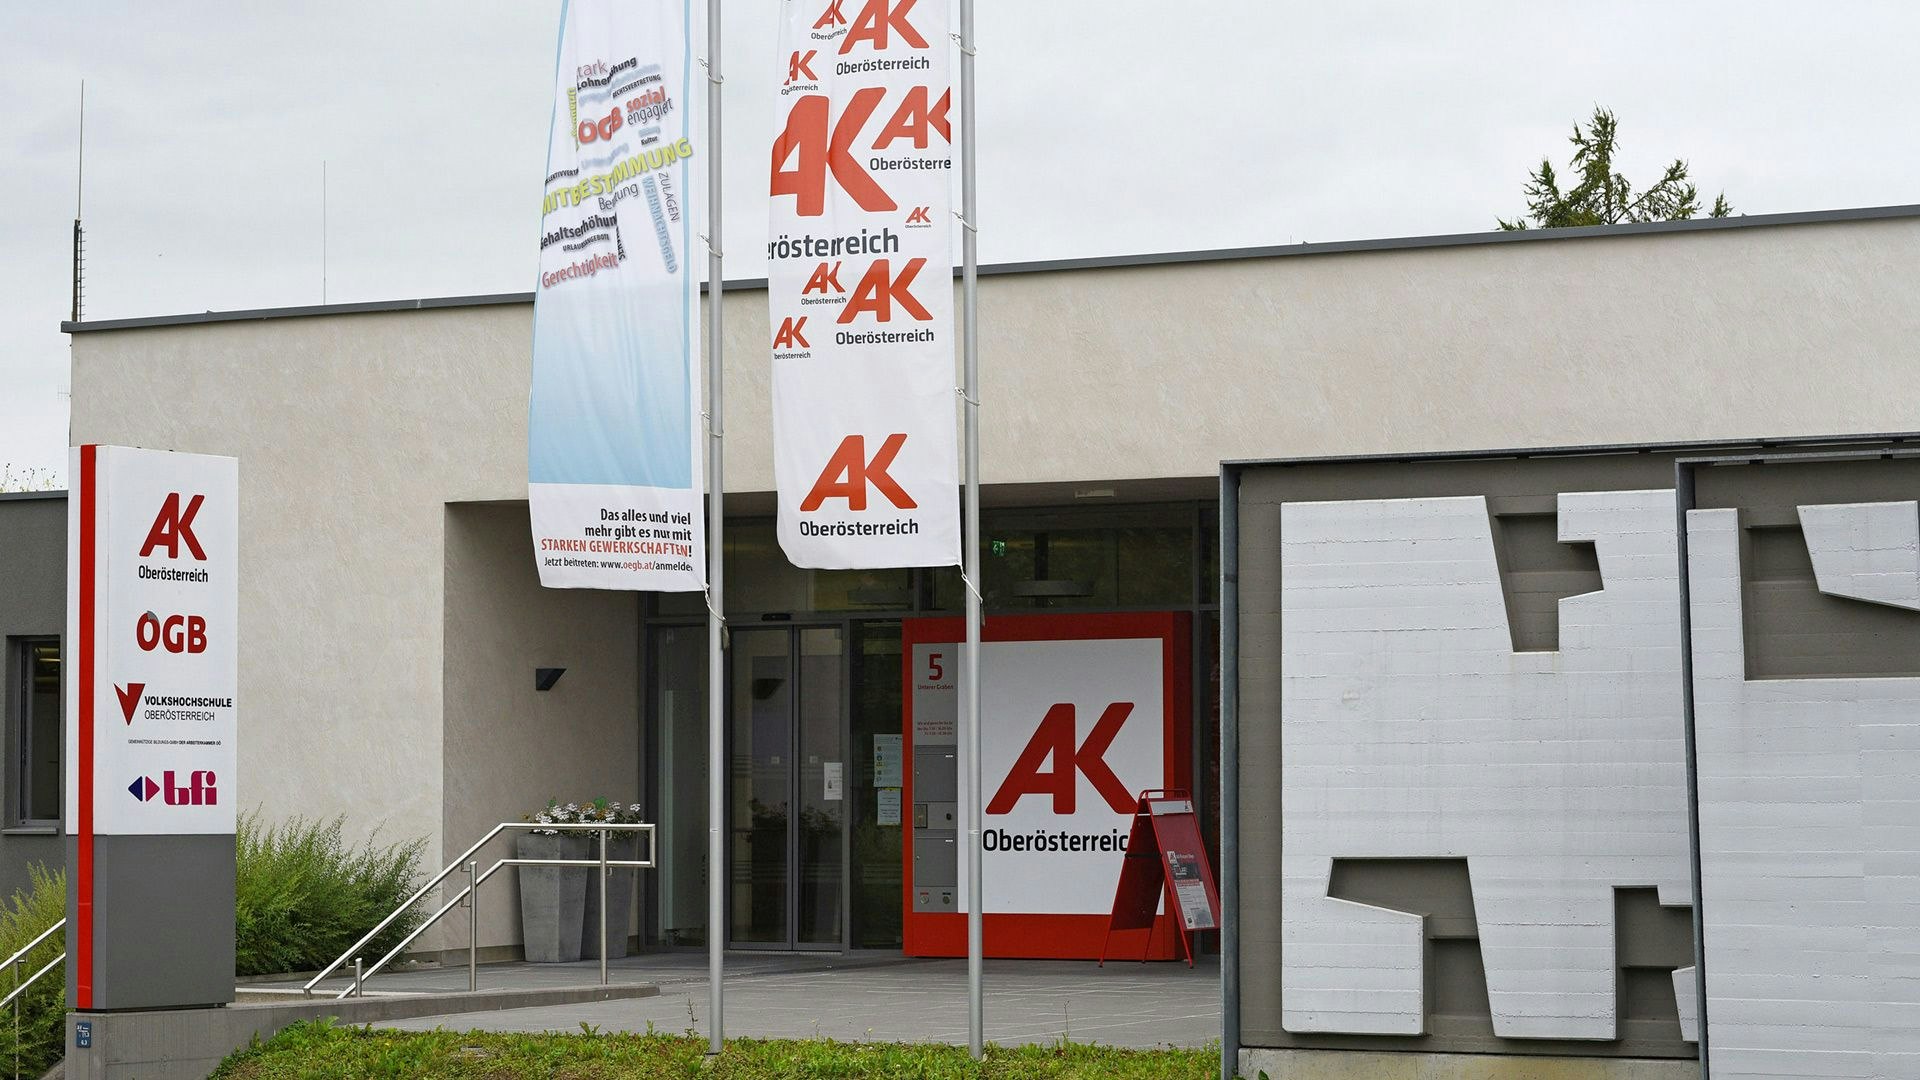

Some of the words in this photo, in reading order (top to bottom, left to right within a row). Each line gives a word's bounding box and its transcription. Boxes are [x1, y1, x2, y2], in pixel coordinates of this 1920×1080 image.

[838, 0, 930, 55] AK
[576, 57, 608, 81] tark
[836, 56, 930, 76] Oberösterreich
[626, 86, 667, 113] sozial
[627, 97, 673, 126] engagiert
[871, 85, 951, 149] AK
[640, 136, 658, 146] Kultur
[770, 86, 898, 216] AK
[658, 172, 680, 223] ZULAGEN
[642, 174, 678, 274] WEIHNACHTSGELD
[905, 206, 932, 223] AK
[768, 228, 899, 261] rösterreich
[541, 251, 619, 288] Gerechtigkeit
[801, 261, 846, 295] AK
[800, 296, 847, 306] Oberösterreich
[836, 257, 934, 324] AK
[773, 316, 810, 349] AK
[835, 328, 935, 345] Oberösterreich
[774, 351, 811, 360] berösterreich
[800, 433, 918, 512] AK
[139, 492, 208, 561] AK
[600, 508, 619, 522] Das
[621, 509, 647, 523] alles
[649, 510, 668, 524] und
[671, 512, 691, 525] viel
[800, 518, 919, 536] Oberösterreich
[585, 524, 612, 537] mehr
[614, 525, 637, 541] gibt
[638, 528, 651, 538] es
[653, 528, 670, 539] nur
[672, 528, 692, 541] mit
[541, 538, 586, 552] STARKEN
[589, 540, 692, 558] GEWERKSCHAFTEN!
[138, 565, 209, 583] Oberösterreich
[544, 556, 562, 567] Jetzt
[563, 557, 599, 568] beitreten:
[928, 653, 943, 681] 5
[144, 696, 232, 708] VOLKSHOCHSCHULE
[144, 709, 215, 721] OBERÖSTERREICH
[985, 702, 1138, 814] AK
[163, 770, 217, 805] bfi
[982, 828, 1129, 852] Oberösterreic
